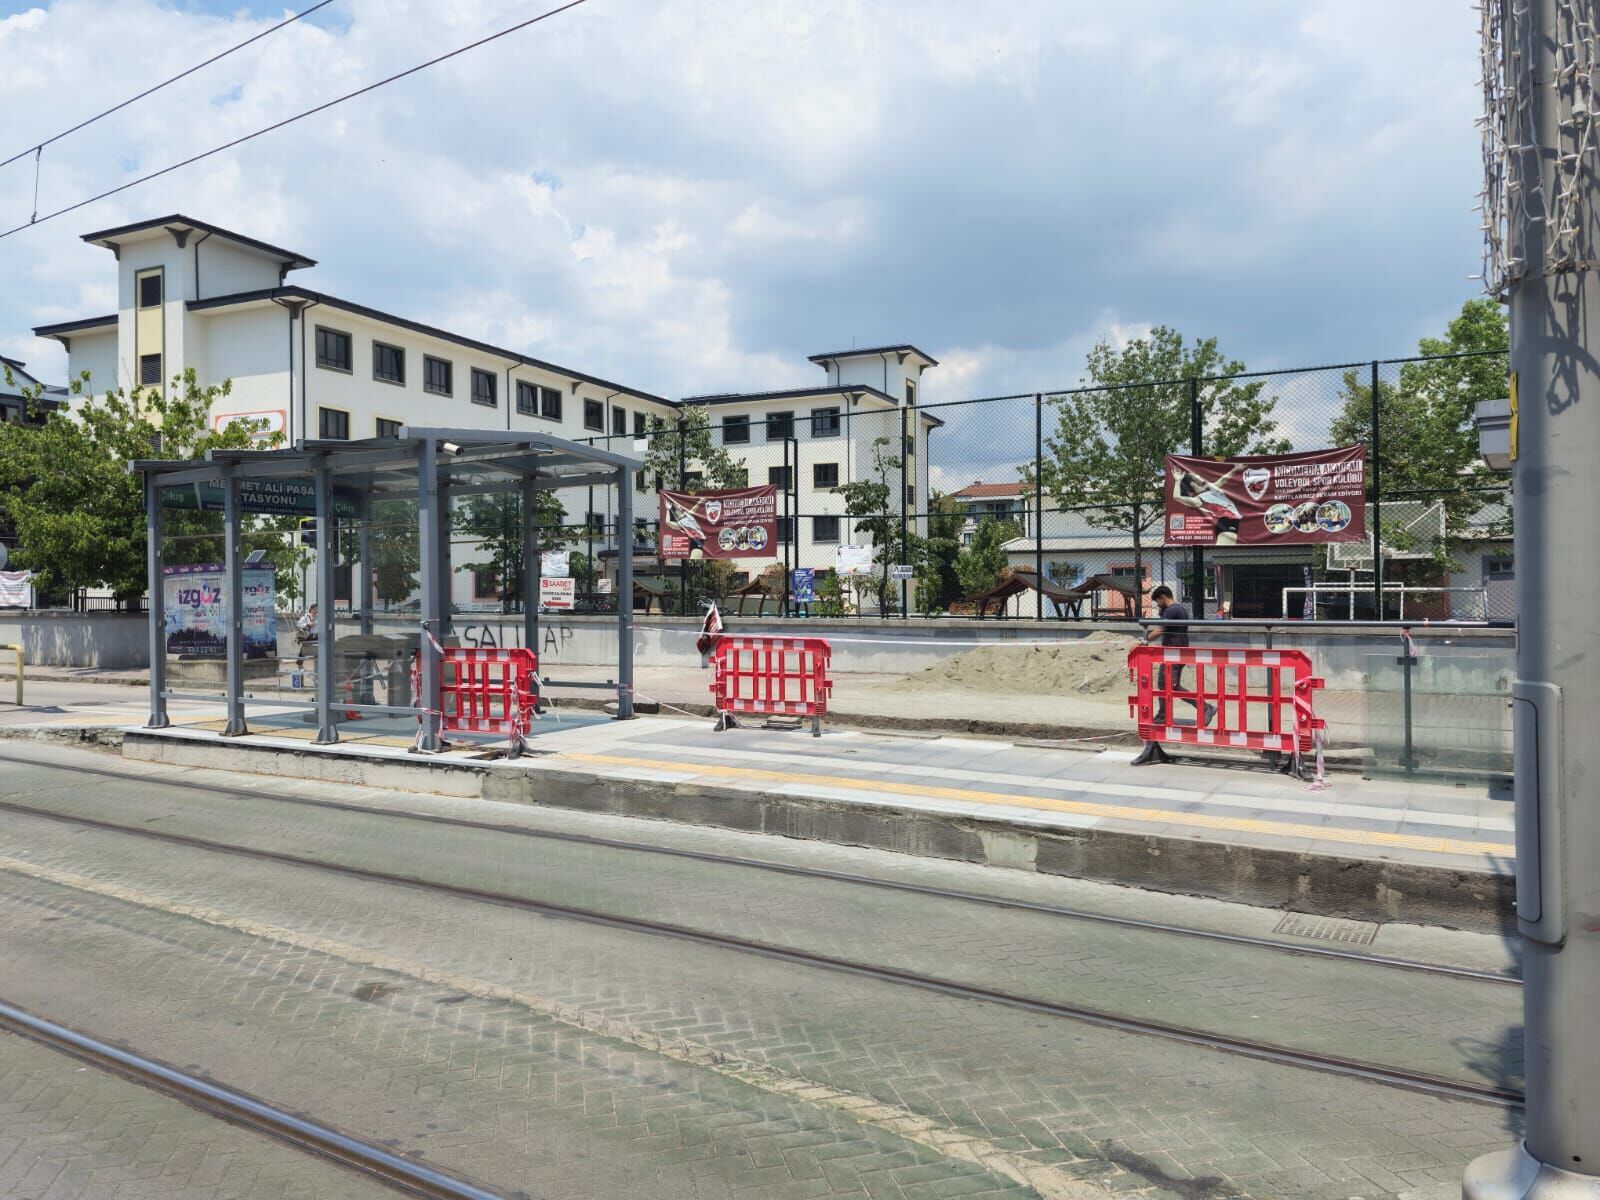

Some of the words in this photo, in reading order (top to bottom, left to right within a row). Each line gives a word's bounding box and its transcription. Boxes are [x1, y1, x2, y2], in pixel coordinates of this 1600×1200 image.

[1275, 476, 1310, 488] VOLEYBOL
[265, 482, 283, 495] ALİ
[286, 486, 315, 497] PAŞA
[548, 580, 572, 588] SAADET
